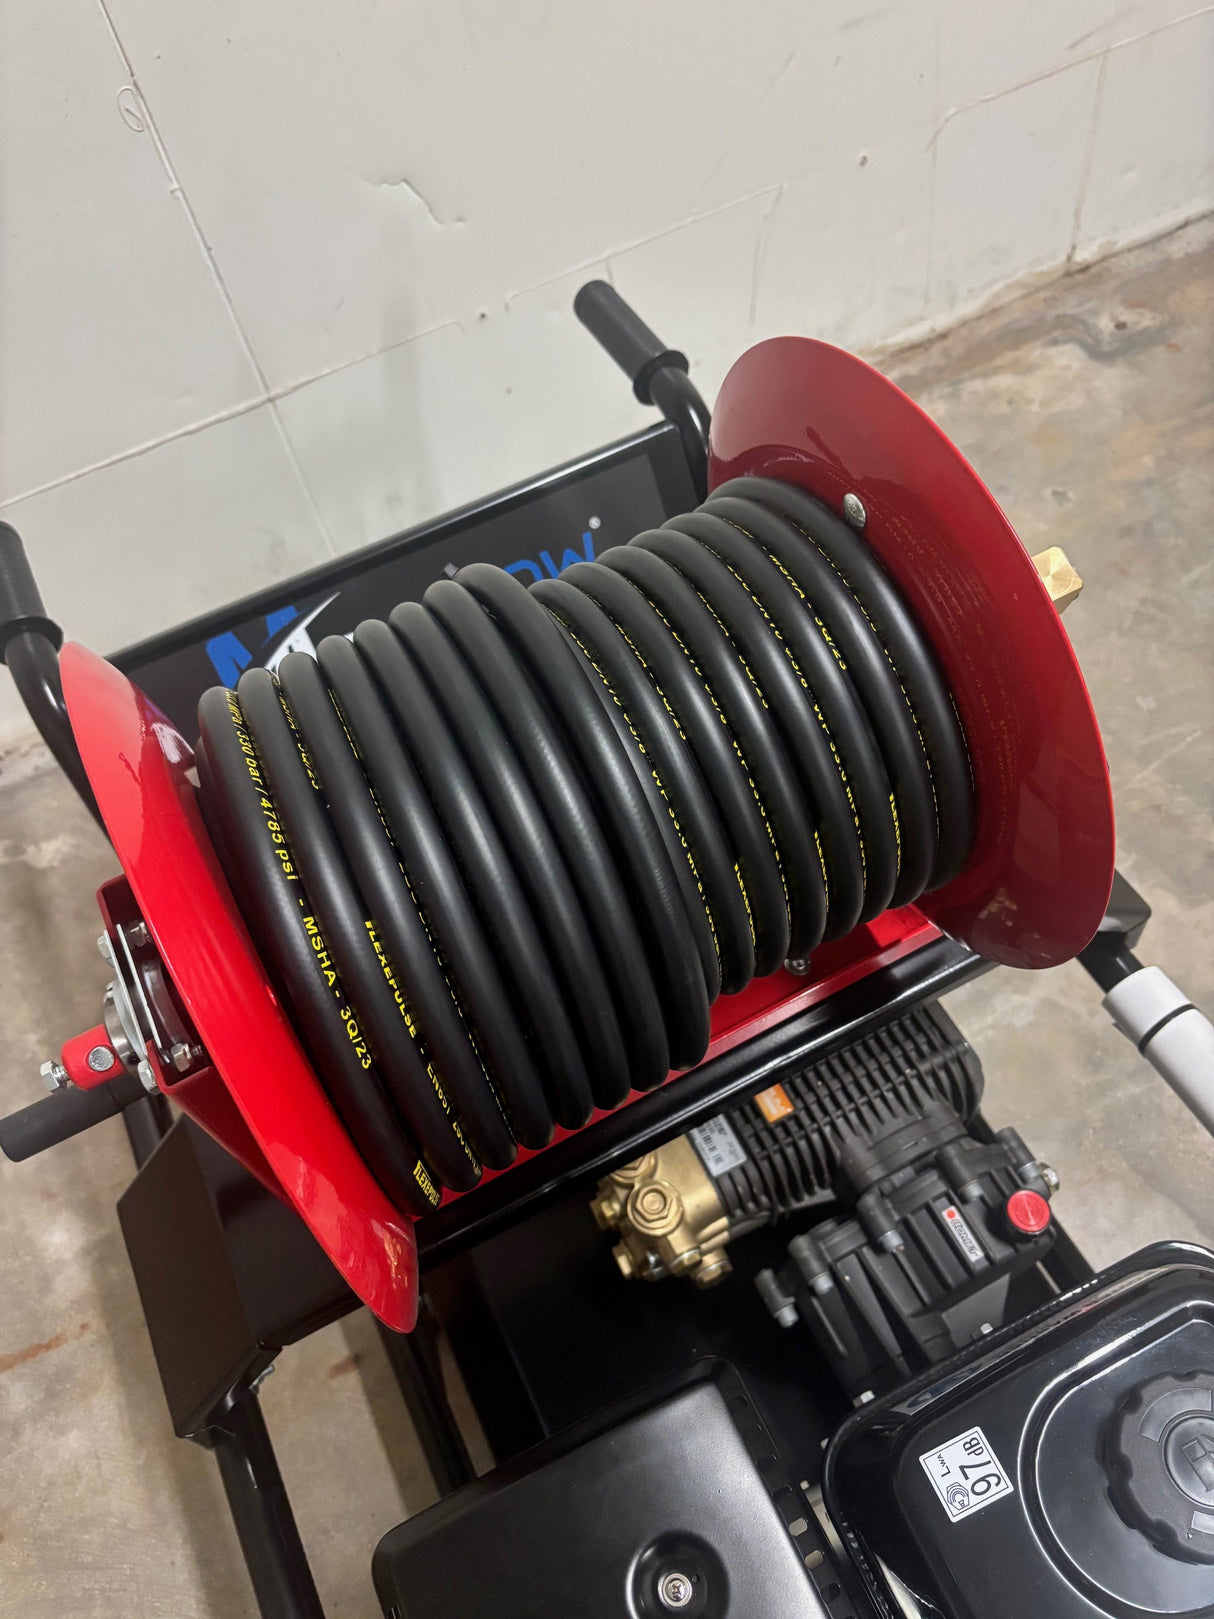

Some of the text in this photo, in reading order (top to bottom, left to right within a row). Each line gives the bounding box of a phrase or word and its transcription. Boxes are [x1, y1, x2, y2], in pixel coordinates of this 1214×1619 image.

[236, 731, 255, 756] 330
[245, 757, 264, 786] bar
[260, 797, 286, 844] 4785
[275, 849, 299, 880] psi
[303, 916, 337, 987] MSHA
[958, 1437, 1002, 1496] 97 dB
